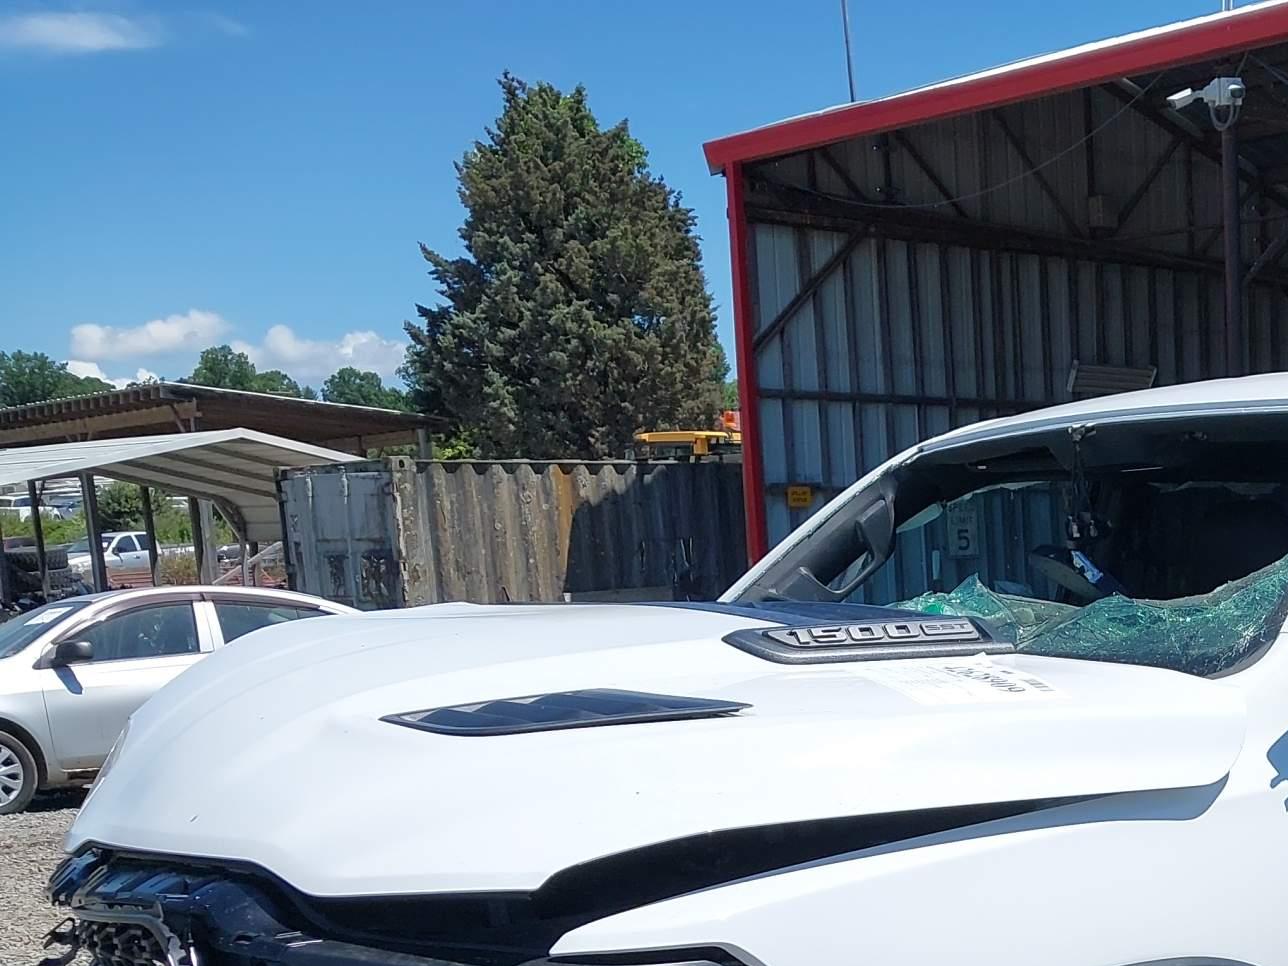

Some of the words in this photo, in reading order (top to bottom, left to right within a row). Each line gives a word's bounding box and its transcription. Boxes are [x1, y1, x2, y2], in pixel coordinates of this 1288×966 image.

[957, 528, 970, 551] 5
[787, 623, 921, 646] 1500
[924, 622, 969, 632] SST
